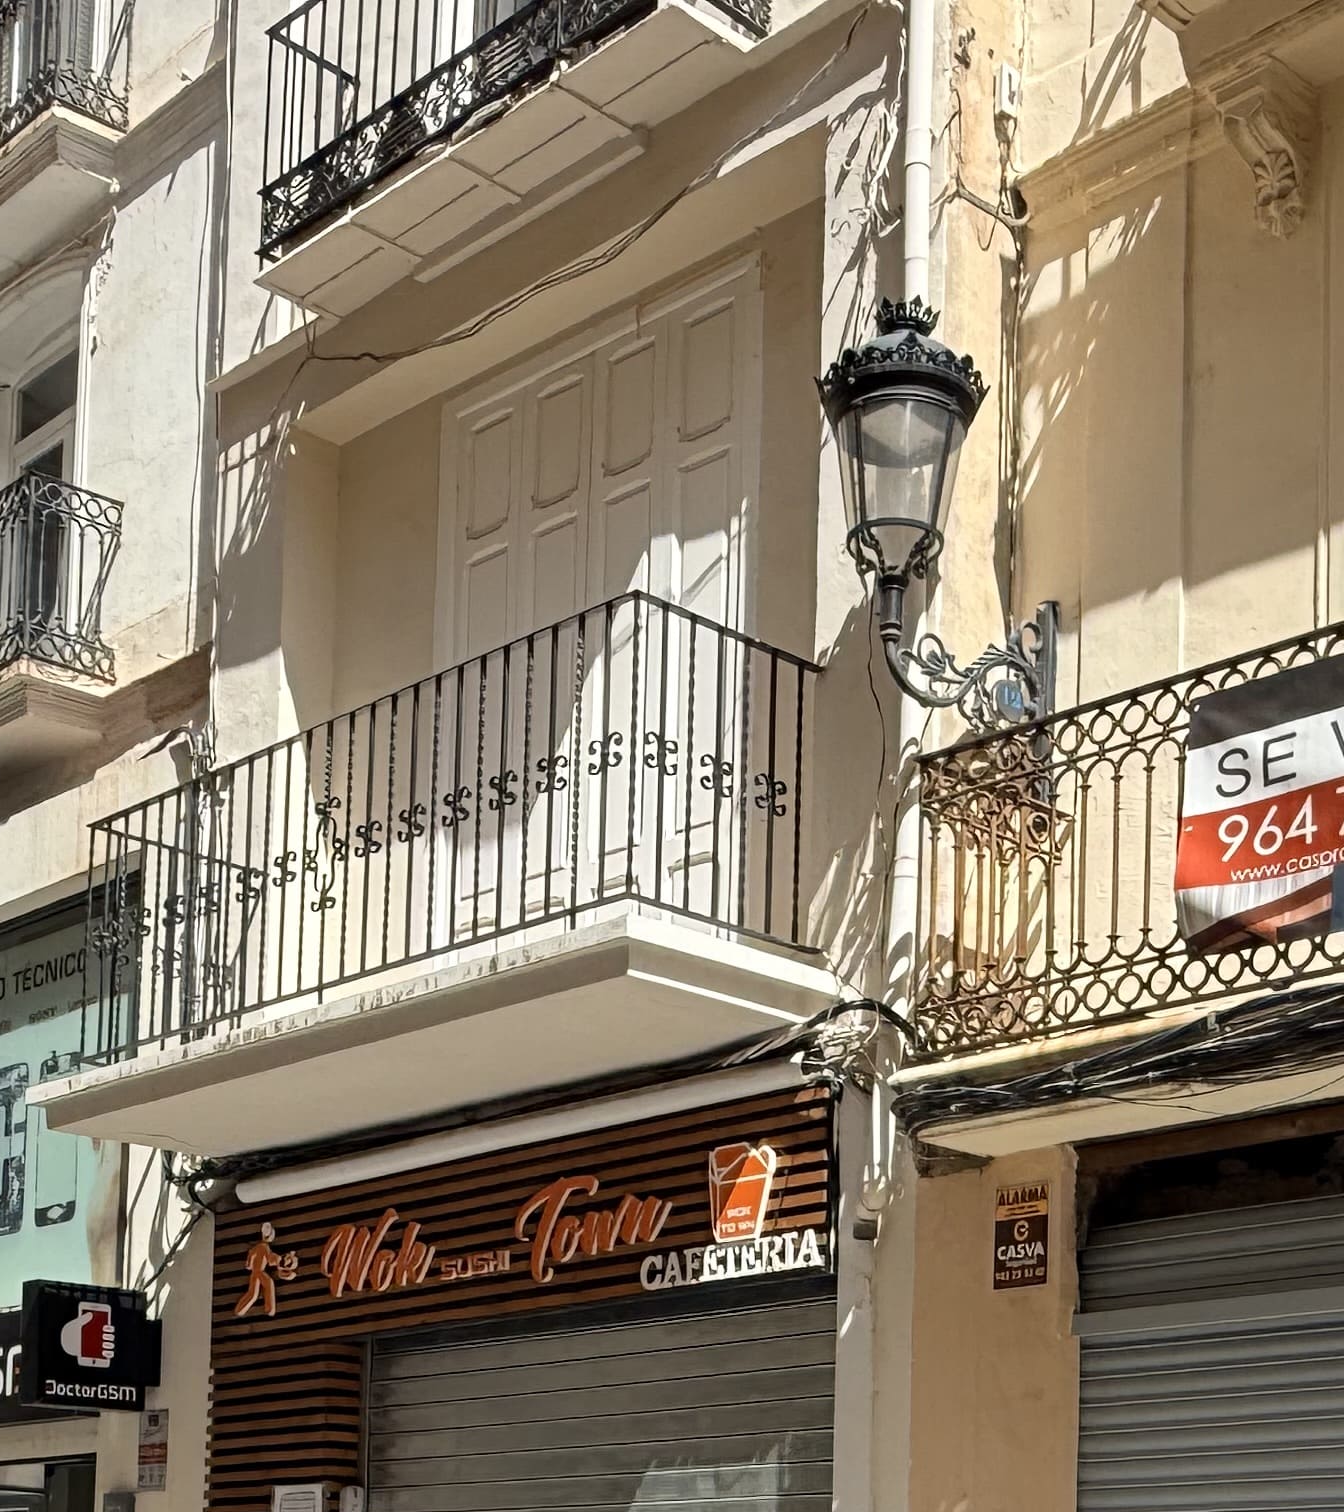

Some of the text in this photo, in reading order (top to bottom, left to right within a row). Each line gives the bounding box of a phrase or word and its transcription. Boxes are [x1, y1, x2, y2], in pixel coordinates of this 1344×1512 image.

[1215, 730, 1298, 798] SE
[1217, 794, 1319, 864] 964
[996, 1184, 1048, 1206] ALARMA
[321, 1175, 673, 1298] Wok SUSHI Town
[640, 1228, 825, 1292] CAFETERIA
[997, 1241, 1045, 1261] CASVA
